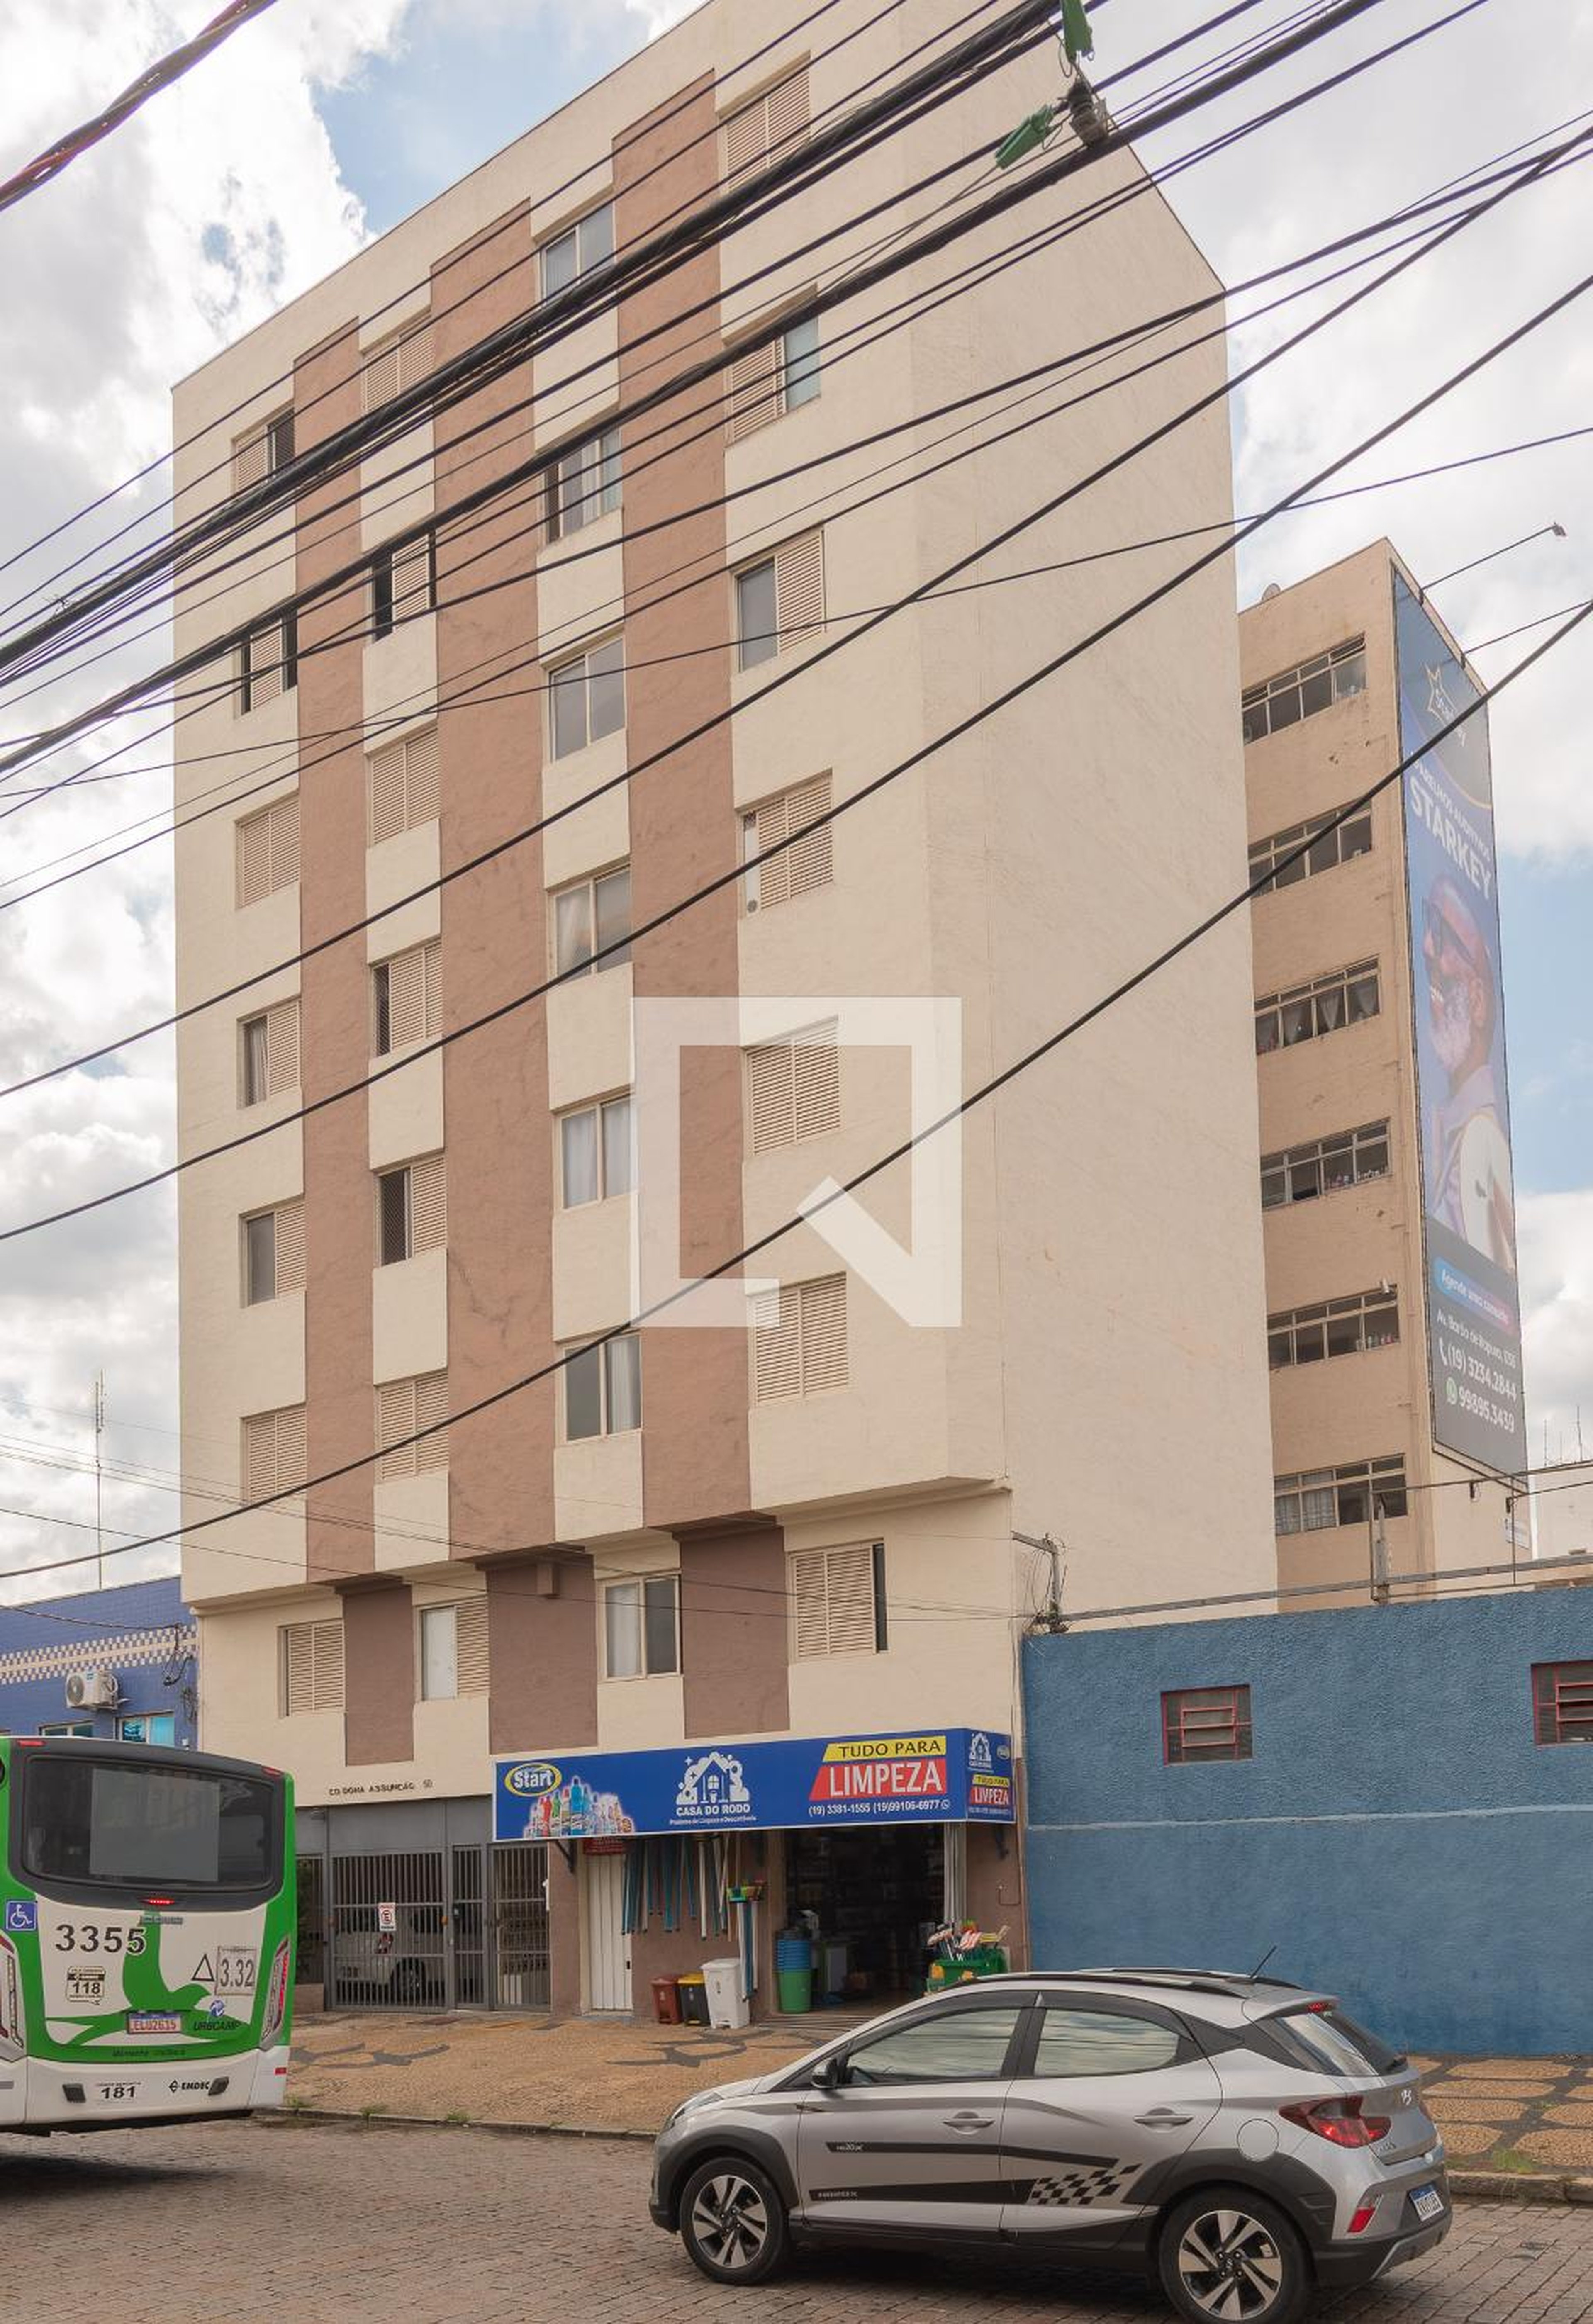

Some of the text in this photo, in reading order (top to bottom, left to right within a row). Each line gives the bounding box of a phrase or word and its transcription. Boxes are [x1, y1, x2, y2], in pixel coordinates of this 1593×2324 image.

[1411, 776, 1491, 900] STARKEY
[1448, 1344, 1467, 1376] (19)
[839, 1740, 941, 1757] TUDO PARA
[514, 1769, 552, 1789] Start
[830, 1760, 943, 1798] LIMPEZA
[676, 1804, 750, 1816] CASA DO RODO
[809, 1806, 825, 1817] (19)
[55, 1924, 145, 1954] 3355
[220, 1958, 254, 1987] 3.32
[73, 1981, 100, 1994] 118
[101, 2086, 135, 2099] 181
[182, 2081, 210, 2090] EMDEC
